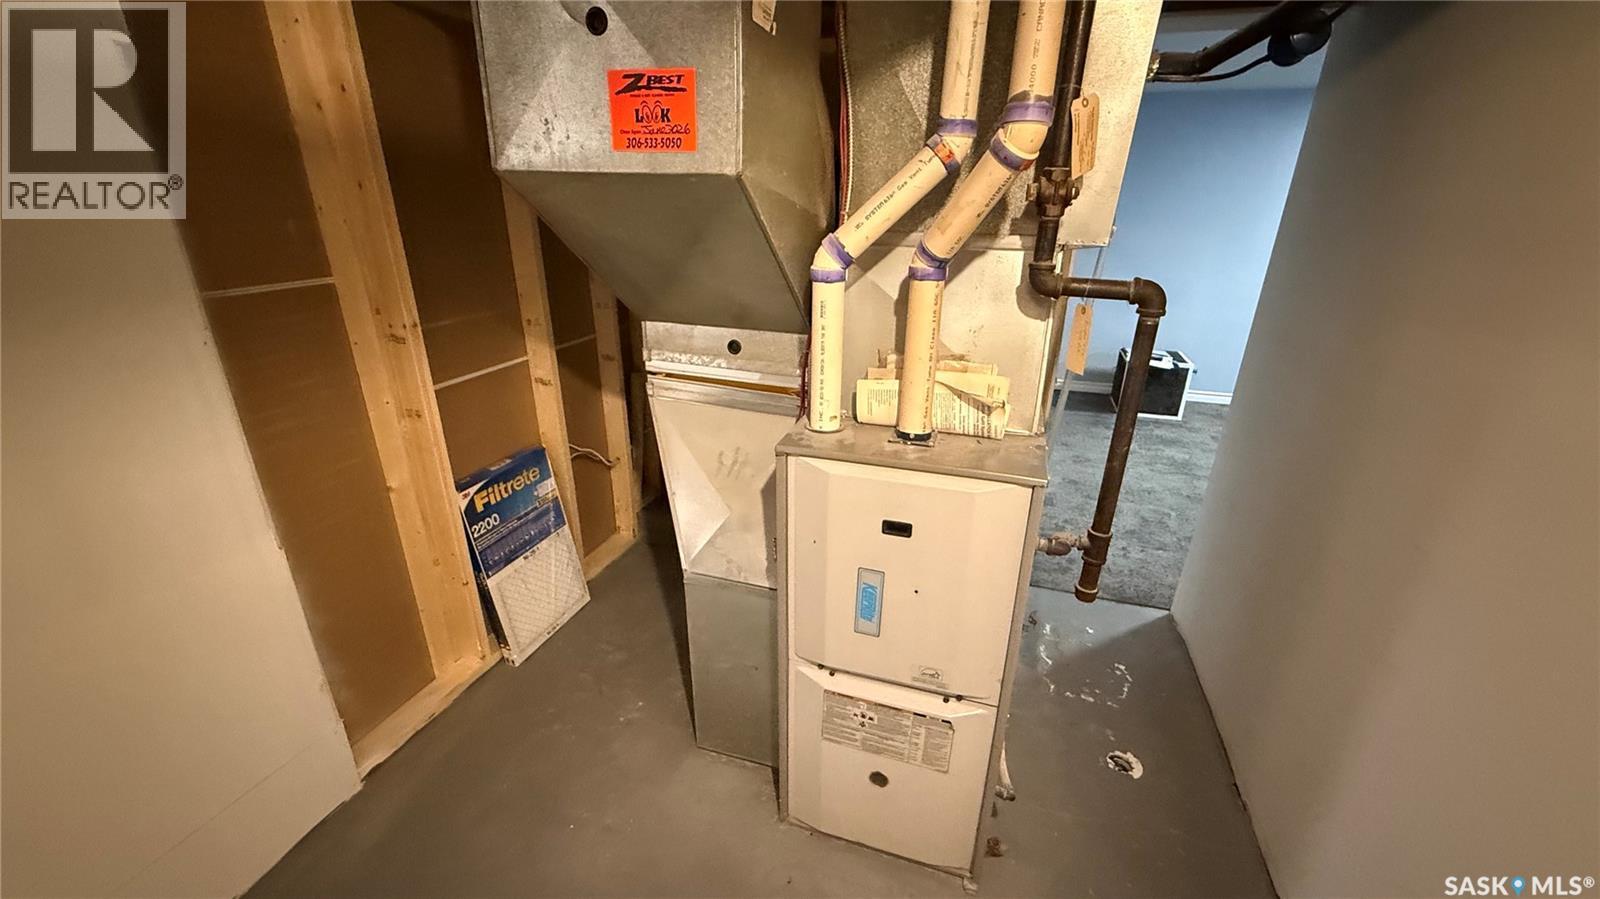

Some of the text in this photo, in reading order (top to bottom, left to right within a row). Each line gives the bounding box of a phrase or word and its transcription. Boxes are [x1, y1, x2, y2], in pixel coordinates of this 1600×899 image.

[634, 105, 671, 124] LOOK
[626, 137, 682, 149] 306-533-5050
[473, 467, 541, 513] Filtrete
[471, 513, 500, 538] 2200
